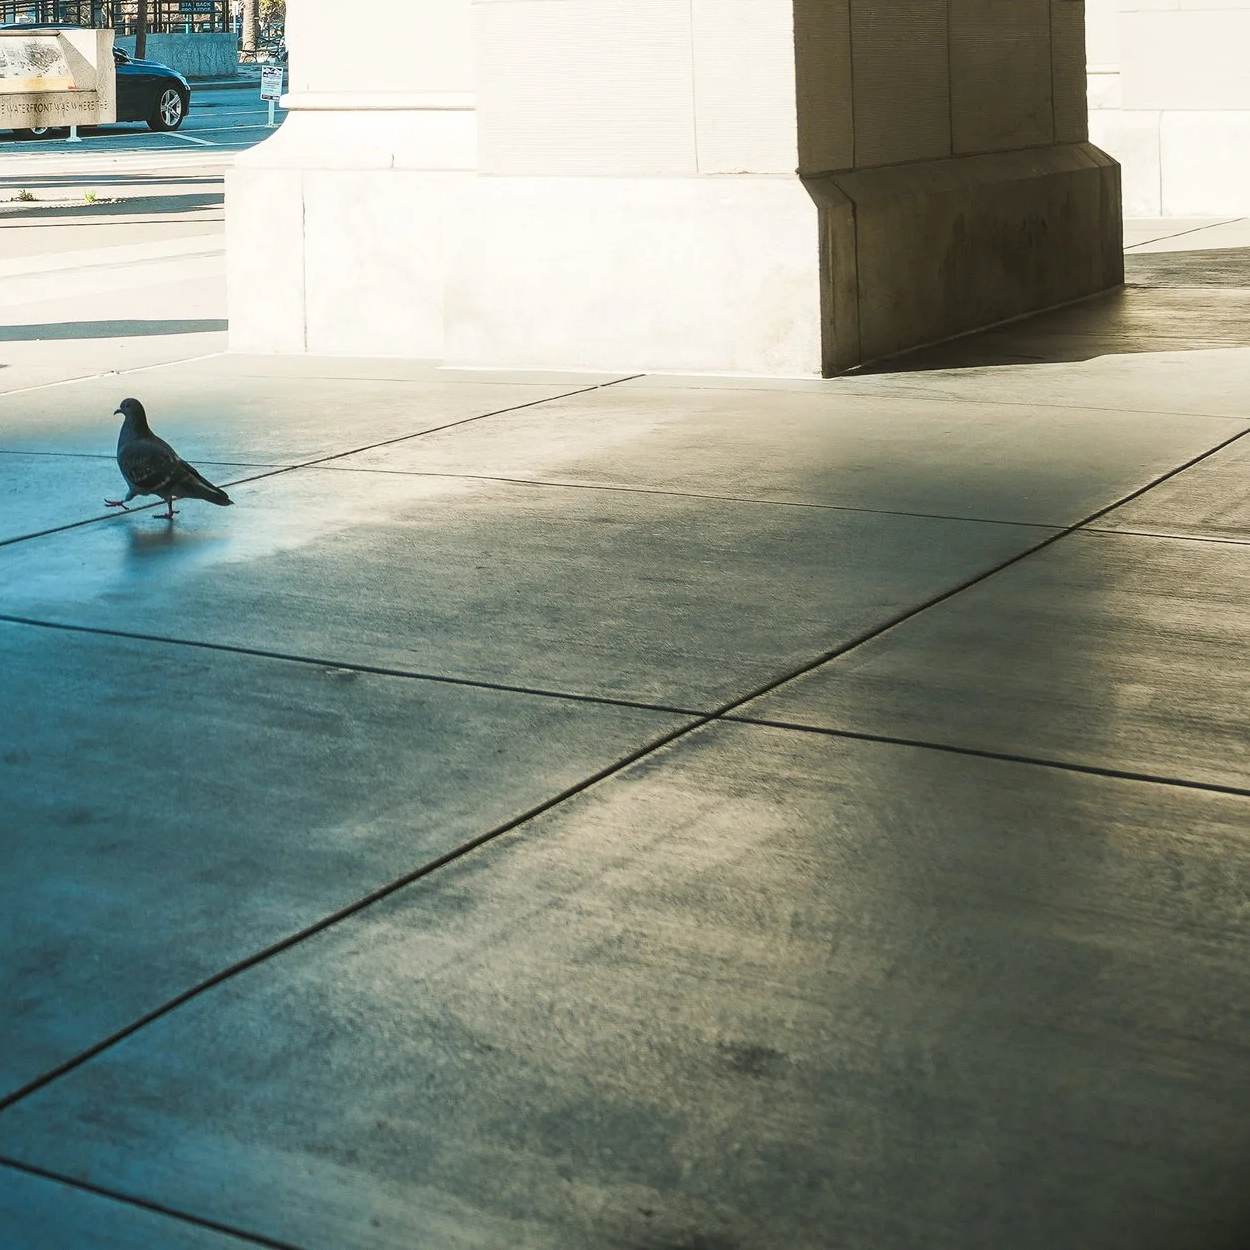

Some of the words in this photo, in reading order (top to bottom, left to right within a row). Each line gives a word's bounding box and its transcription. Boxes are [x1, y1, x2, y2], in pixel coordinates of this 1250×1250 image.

[7, 103, 52, 113] WATERFRONT
[54, 102, 69, 111] WAS
[71, 100, 95, 111] WHERE
